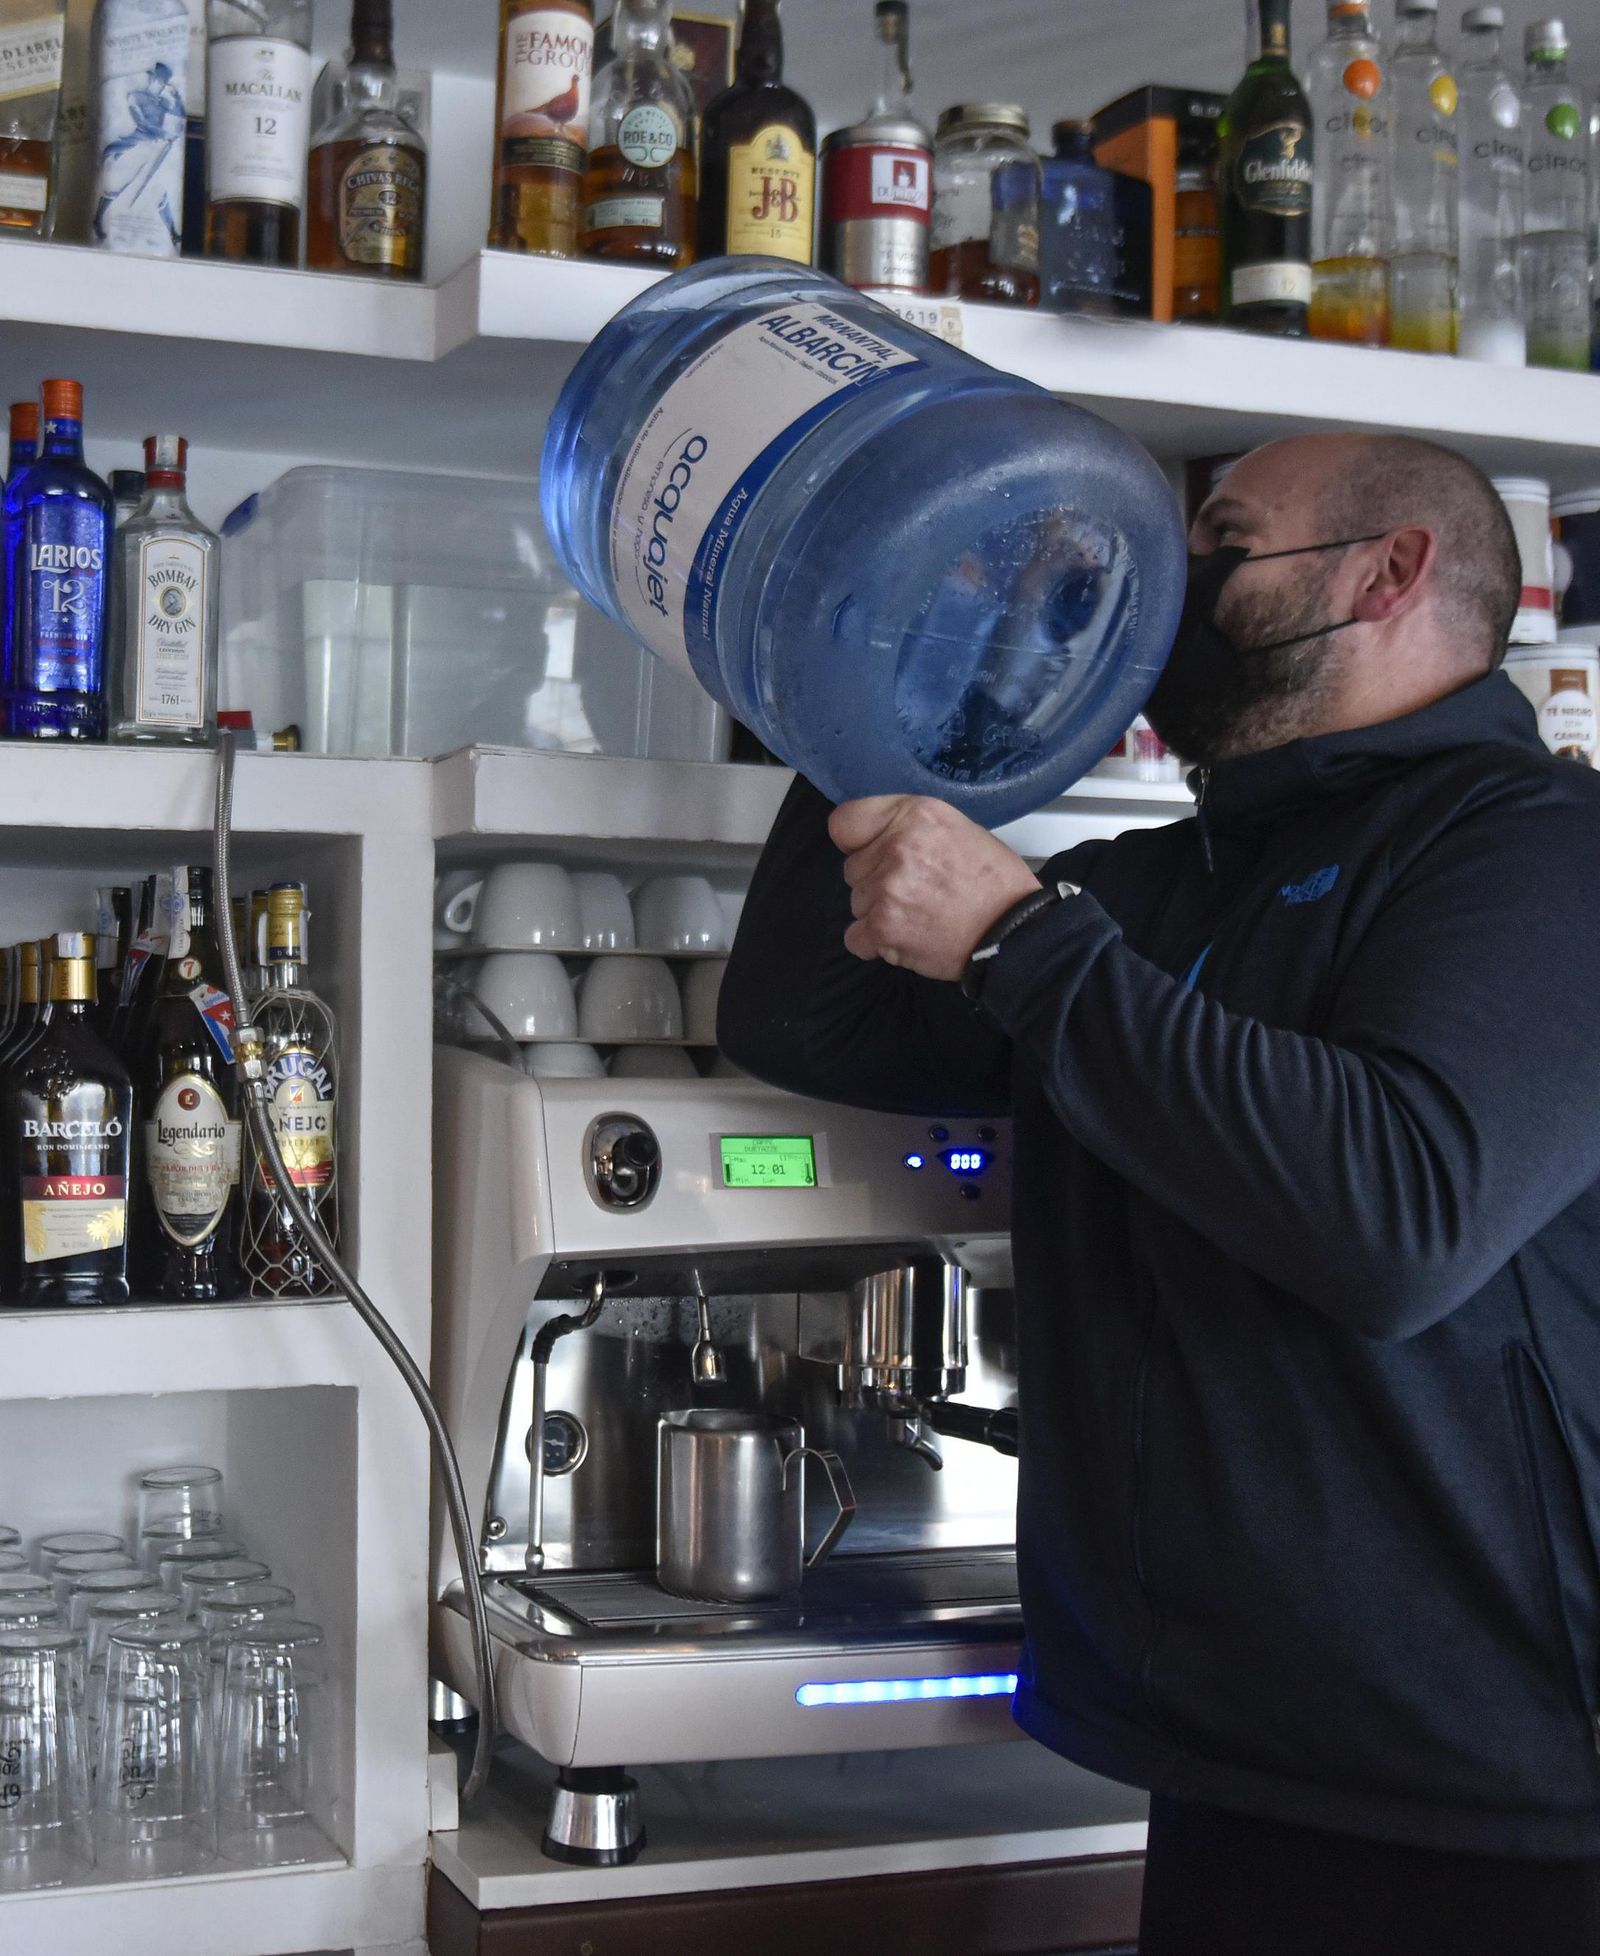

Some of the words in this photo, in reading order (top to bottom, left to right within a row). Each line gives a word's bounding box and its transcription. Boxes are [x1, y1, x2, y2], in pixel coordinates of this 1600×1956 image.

[529, 32, 592, 60] FAMOU
[254, 116, 278, 136] 12
[623, 131, 673, 147] ROE&CO
[347, 172, 392, 189] CHIVAS
[813, 315, 899, 360] MANANTIAL
[723, 487, 749, 527] Agua
[642, 434, 708, 618] acquajet
[31, 543, 103, 574] LARIOS
[705, 529, 729, 587] Mineral
[147, 569, 199, 592] BOMBAY
[42, 578, 88, 617] 12
[147, 614, 173, 634] DRY
[174, 616, 197, 635] GIN
[161, 694, 181, 705] 1761
[183, 960, 195, 977] 7
[263, 1056, 332, 1101] BRUGAL
[23, 1116, 123, 1140] BARCELÓ
[157, 1118, 226, 1147] Legendario
[273, 1112, 326, 1133] ÑEJO
[37, 1143, 56, 1151] RON
[43, 1180, 106, 1196] AÑEJO
